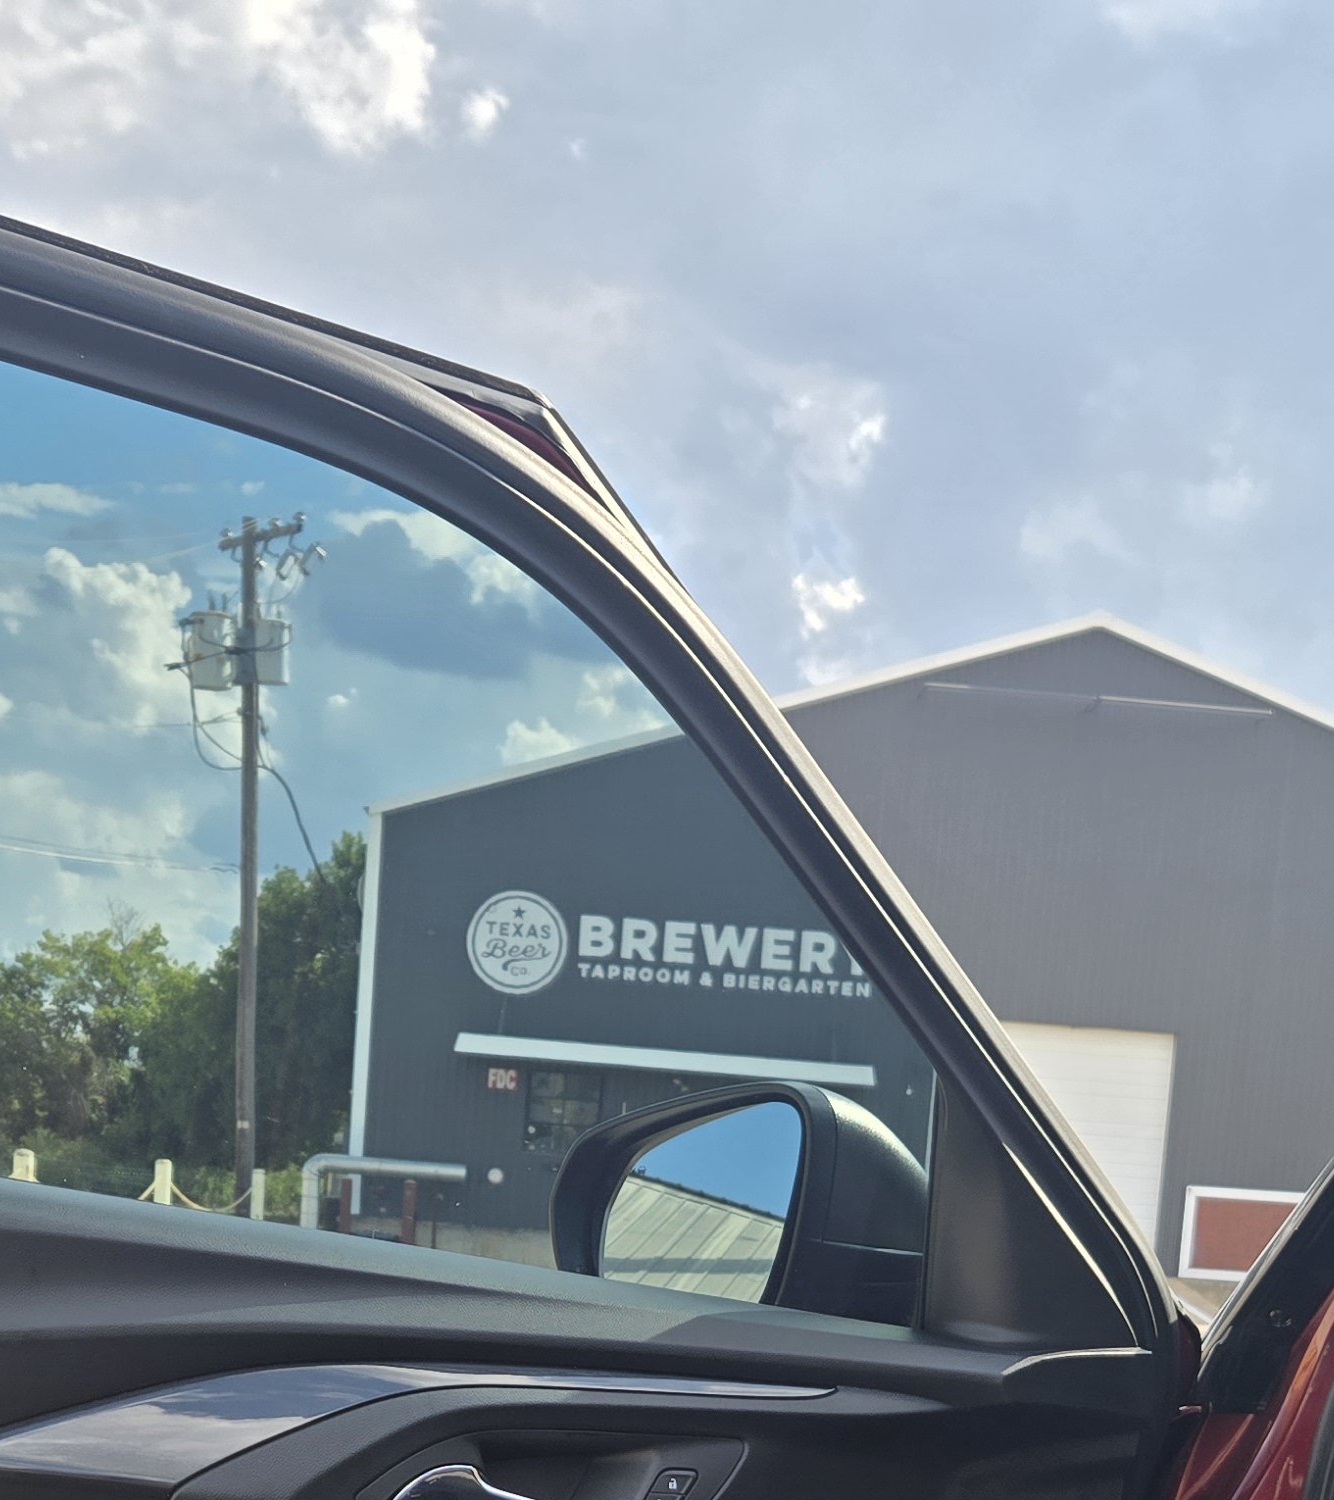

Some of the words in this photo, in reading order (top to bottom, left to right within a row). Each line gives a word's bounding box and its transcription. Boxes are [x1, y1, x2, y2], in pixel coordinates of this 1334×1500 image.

[486, 921, 551, 940] TEXAS
[481, 938, 551, 964] Beer
[578, 963, 691, 986] TAPROOM
[699, 971, 713, 987] &
[723, 973, 872, 998] BIERGARTEN
[487, 1068, 516, 1090] FDC
